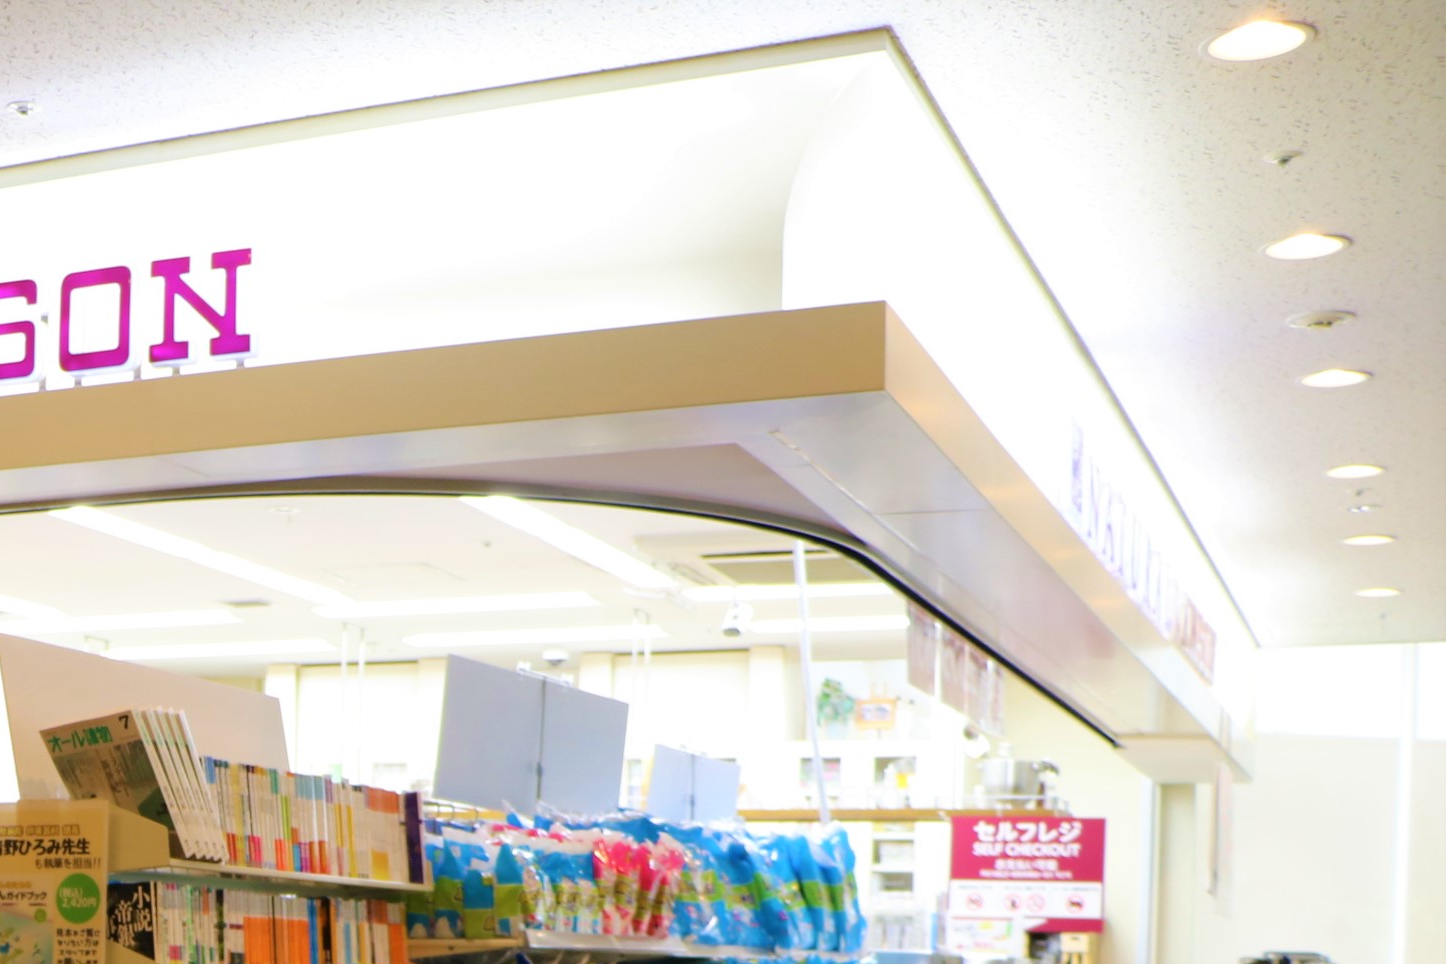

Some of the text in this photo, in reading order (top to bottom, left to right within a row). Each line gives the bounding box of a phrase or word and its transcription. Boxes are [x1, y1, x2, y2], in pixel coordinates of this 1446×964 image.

[118, 715, 129, 730] 7
[972, 820, 1083, 843] セルフレジ
[130, 885, 153, 932] 小説
